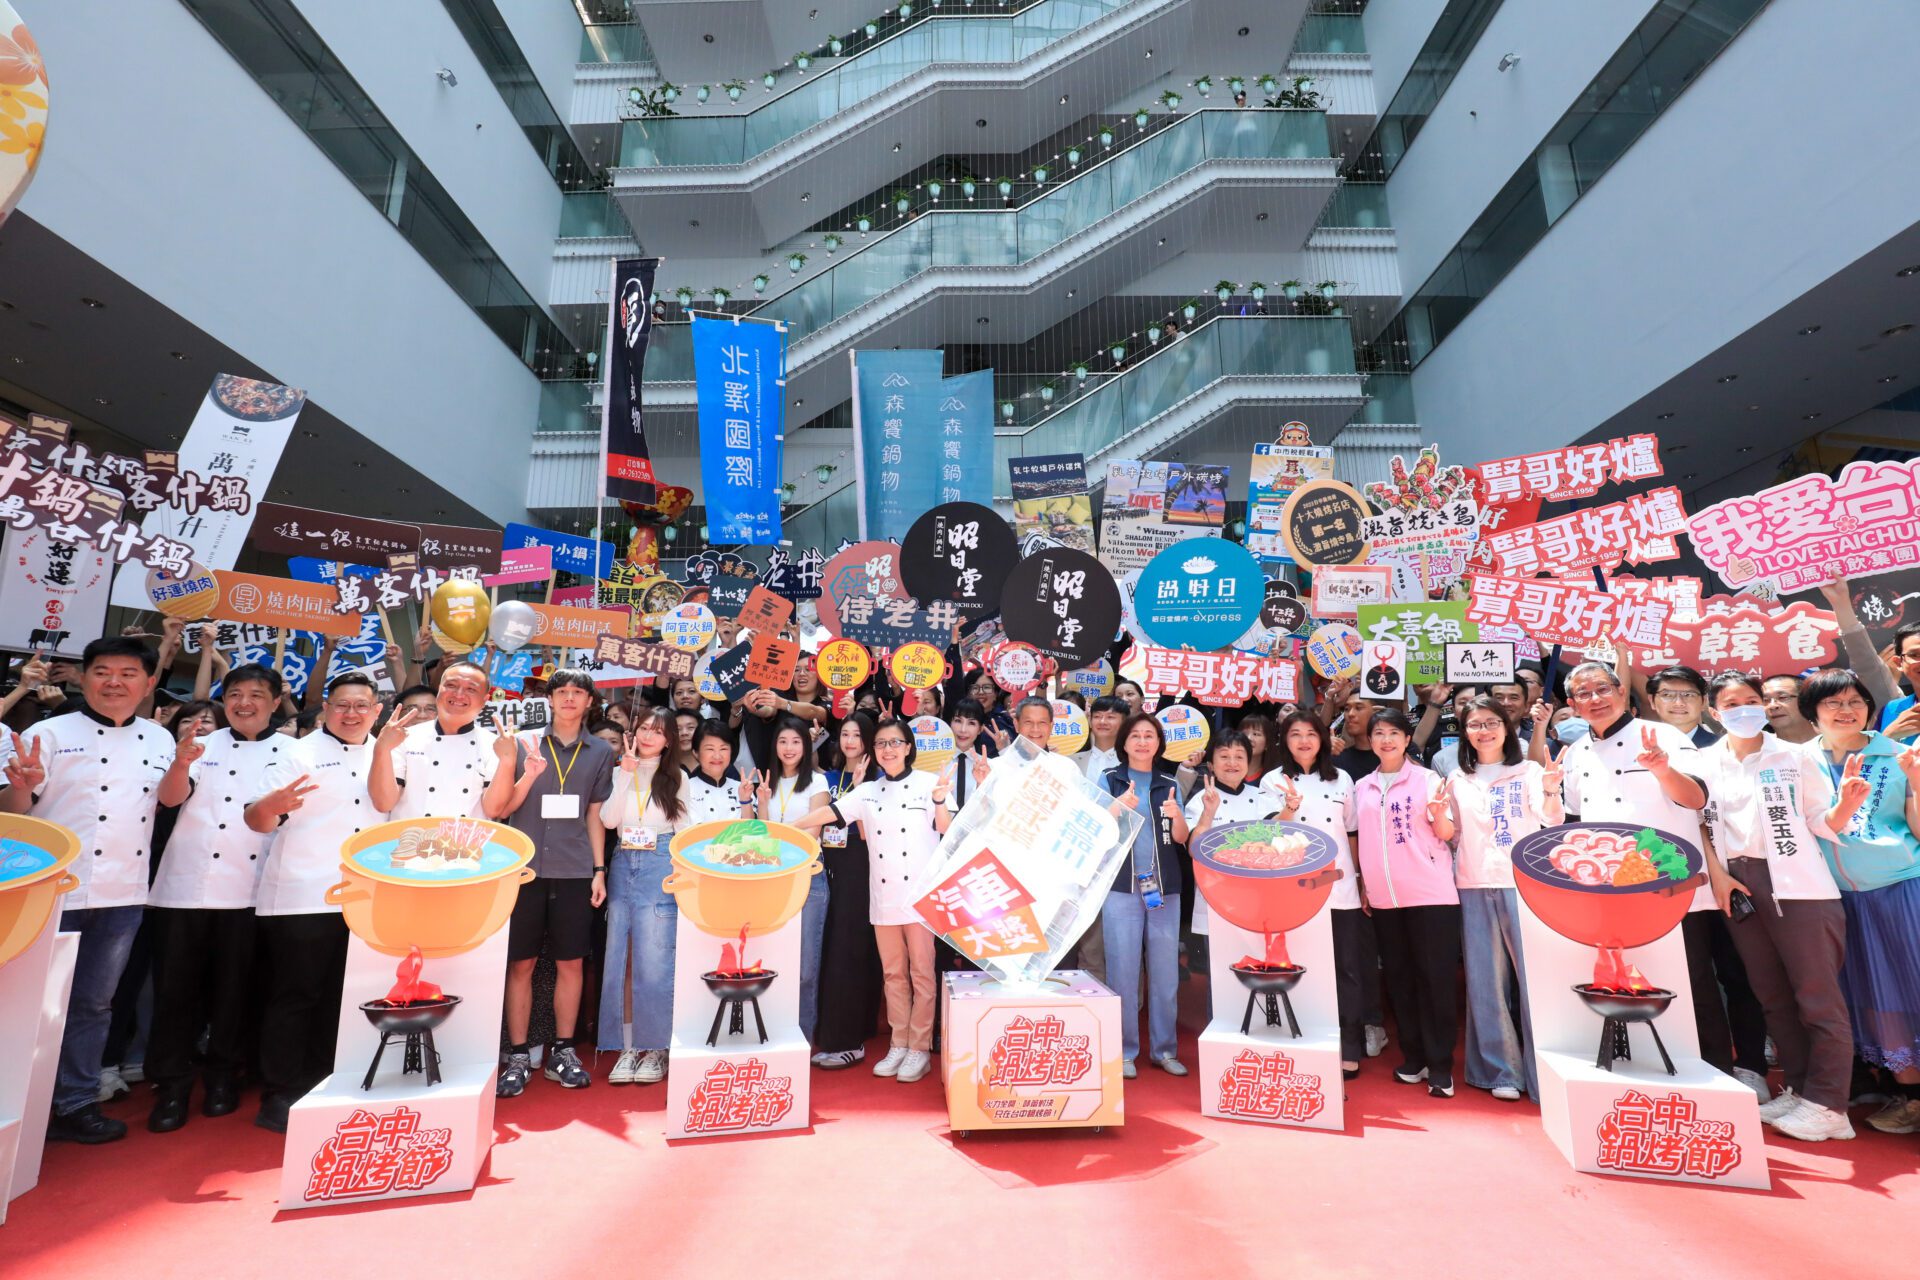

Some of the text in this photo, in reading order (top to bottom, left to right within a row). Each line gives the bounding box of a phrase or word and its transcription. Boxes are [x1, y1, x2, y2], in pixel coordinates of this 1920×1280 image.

[881, 394, 905, 493] 森饗鍋物
[943, 418, 963, 503] 森饗鍋物
[1481, 437, 1659, 502] 賢哥好爐
[1128, 494, 1163, 510] LOVE
[1296, 499, 1351, 523] 十大燒烤名店
[1549, 486, 1595, 499] SINCE 1956
[1143, 527, 1178, 537] Witamy
[1311, 517, 1346, 538] 第一名
[1490, 490, 1686, 577] 賢哥好爐
[1692, 465, 1920, 566] 我愛台
[1099, 546, 1135, 555] Welkom
[1108, 539, 1153, 548] Välkommen
[1124, 534, 1153, 542] SHALOM
[1765, 523, 1920, 573] LOVE TAICHU
[763, 548, 825, 589] 老井
[948, 520, 983, 598] 昭日堂
[1563, 570, 1588, 579] SINCE
[1570, 550, 1620, 568] SINCE 1956
[1780, 545, 1916, 589] 屋馬餐飲集團
[152, 576, 214, 601] 好運燒肉
[665, 621, 713, 633] 阿官火鍋
[839, 595, 958, 631] 侍老井
[1053, 570, 1086, 648] 昭日堂
[1193, 609, 1242, 624] express
[1469, 575, 1669, 648] 賢哥好爐
[676, 635, 700, 647] 專家
[1368, 609, 1463, 651] 大喜鍋
[1534, 630, 1561, 642] SINCE
[1562, 634, 1584, 645] 1956
[597, 636, 692, 678] 萬客什鍋
[1067, 652, 1082, 661] DOU
[1309, 641, 1338, 679] 鍋物堂
[1325, 635, 1352, 671] 十二段
[1419, 664, 1445, 675] 超好
[1148, 650, 1298, 700] 賢哥好爐
[1481, 670, 1508, 678] TAKUMI
[1201, 695, 1241, 706] SINCE 1956
[1489, 786, 1513, 848] 張廖乃綸
[1508, 781, 1523, 819] 市議員
[1767, 805, 1798, 857] 麥玉珍
[929, 862, 1022, 927] 汽車
[963, 914, 1040, 957] 大獎
[1005, 1015, 1088, 1050] 台中 2024
[706, 1058, 790, 1095] 台中 2024
[990, 1050, 1091, 1087] 鍋烤節
[1234, 1048, 1321, 1087] 台中 2024
[685, 1091, 793, 1133] 鍋烤節
[1218, 1082, 1324, 1122] 鍋烤節
[1614, 1089, 1734, 1138] 台中 2024
[337, 1106, 451, 1152] 台中 2024
[1598, 1129, 1741, 1179] 鍋烤節
[305, 1146, 453, 1201] 鍋烤節
